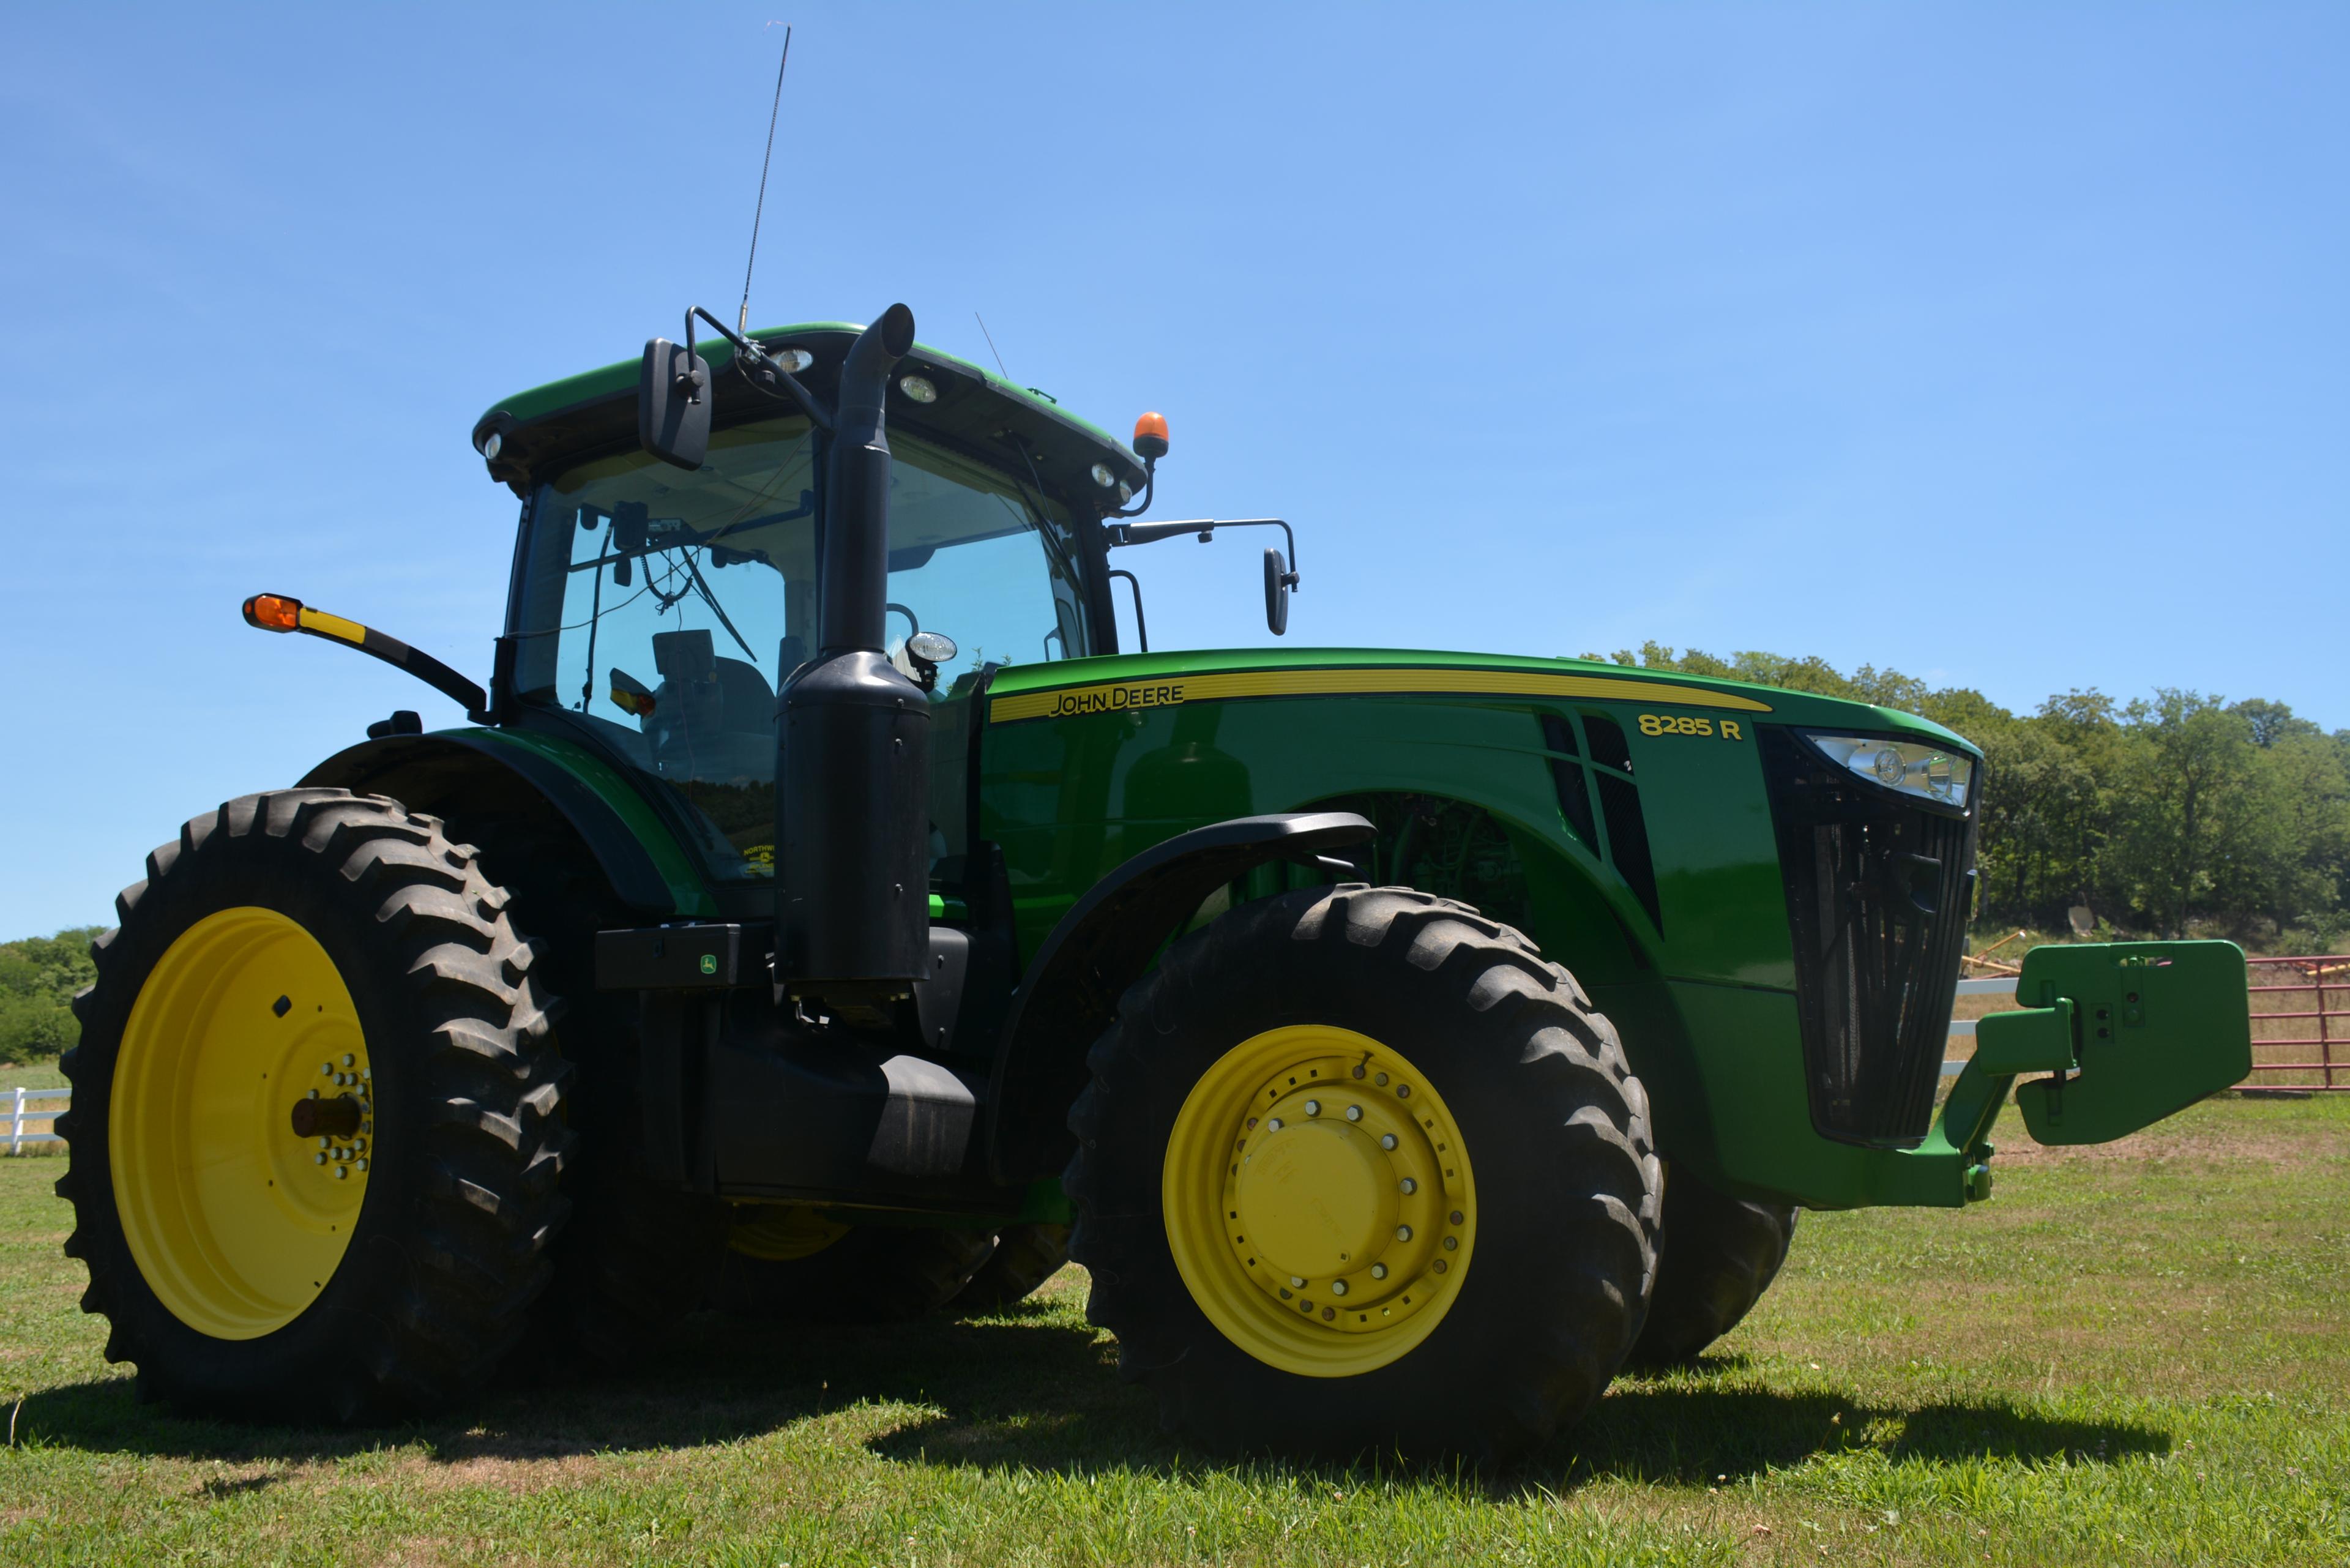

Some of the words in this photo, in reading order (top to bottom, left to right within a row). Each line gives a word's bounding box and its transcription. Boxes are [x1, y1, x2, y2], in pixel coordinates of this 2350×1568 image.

[1050, 692, 1106, 715] JOHN
[1112, 685, 1184, 705] DEERE
[1638, 714, 1714, 737] 8285
[1719, 720, 1743, 741] R
